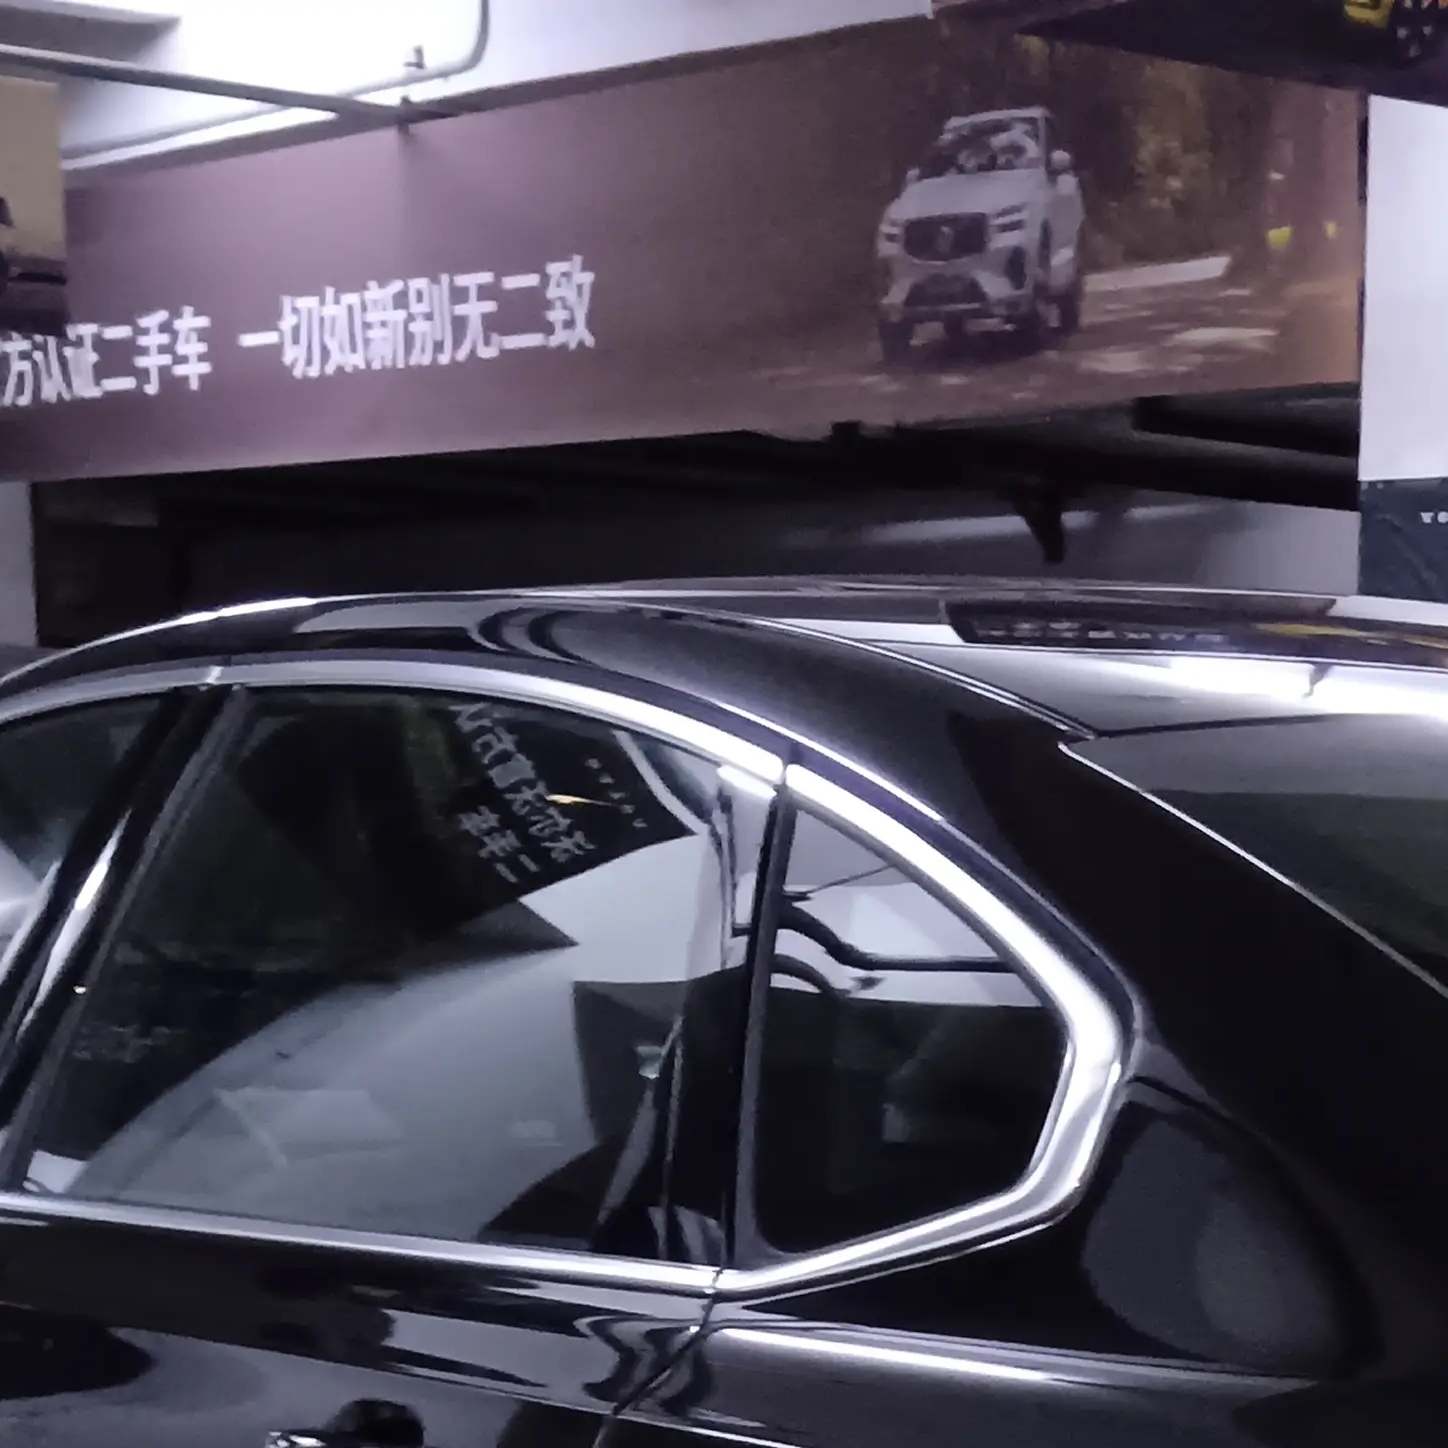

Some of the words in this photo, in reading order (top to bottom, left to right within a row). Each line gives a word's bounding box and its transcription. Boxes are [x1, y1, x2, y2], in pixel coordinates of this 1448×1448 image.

[238, 254, 595, 378] 一切如新别无二致
